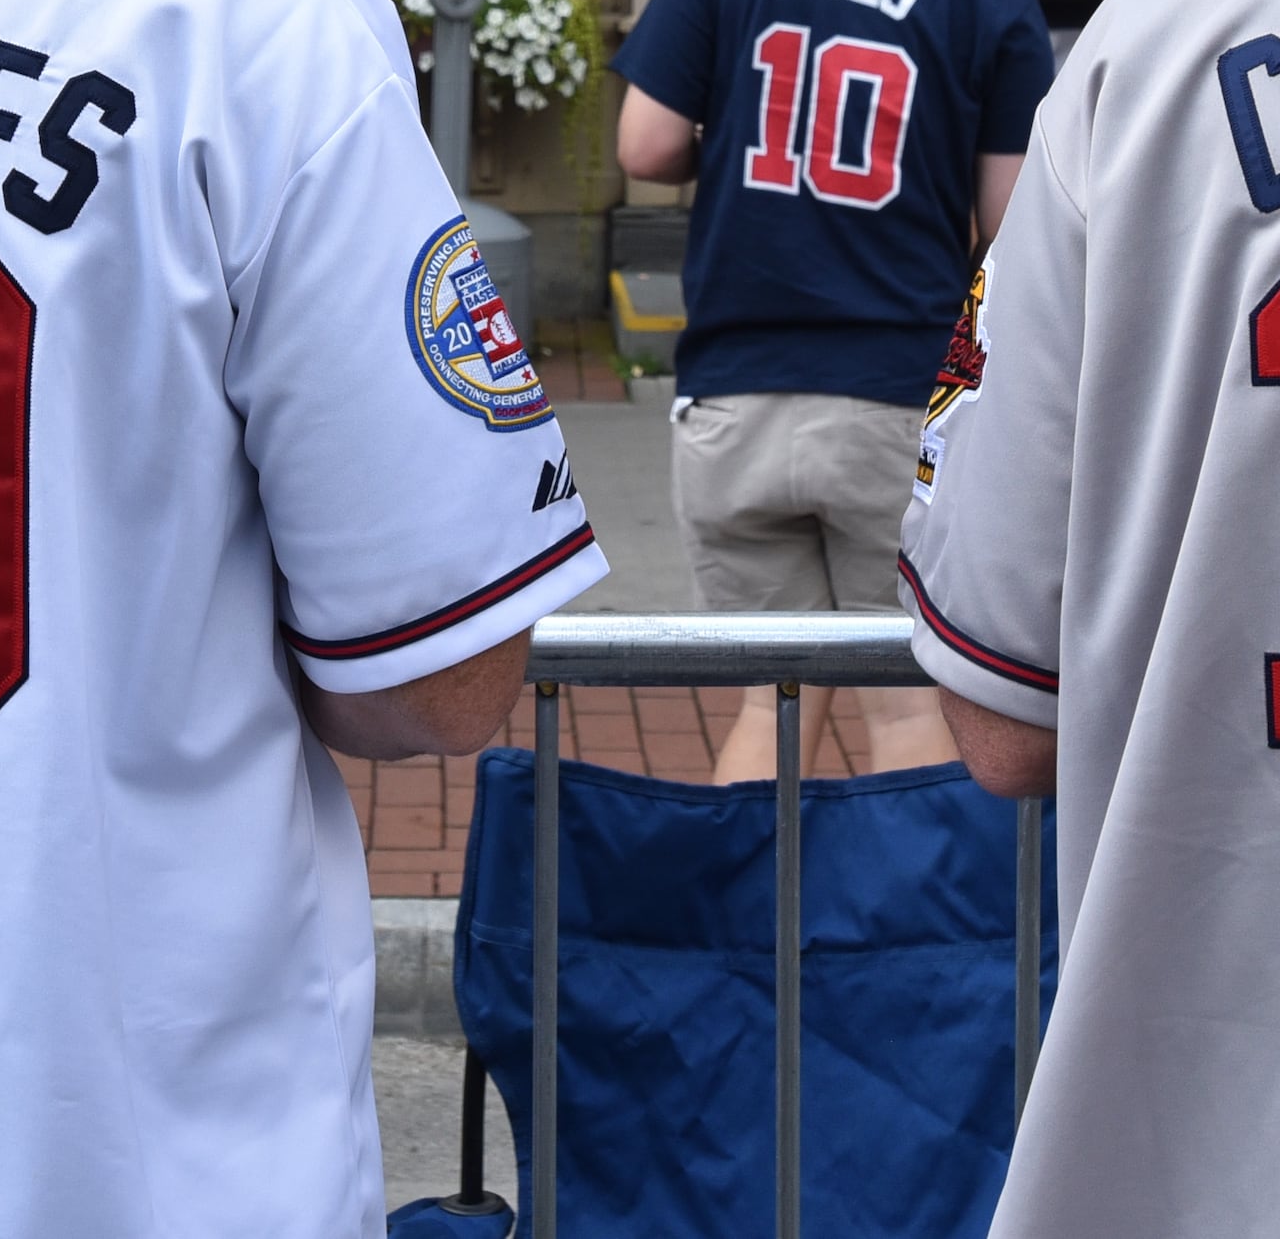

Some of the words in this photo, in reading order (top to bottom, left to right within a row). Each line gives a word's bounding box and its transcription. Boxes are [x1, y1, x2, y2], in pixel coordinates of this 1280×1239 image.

[743, 21, 918, 211] 10
[420, 244, 454, 340] PRESERVING
[430, 344, 491, 404] CONNECTING
[443, 321, 472, 354] 20
